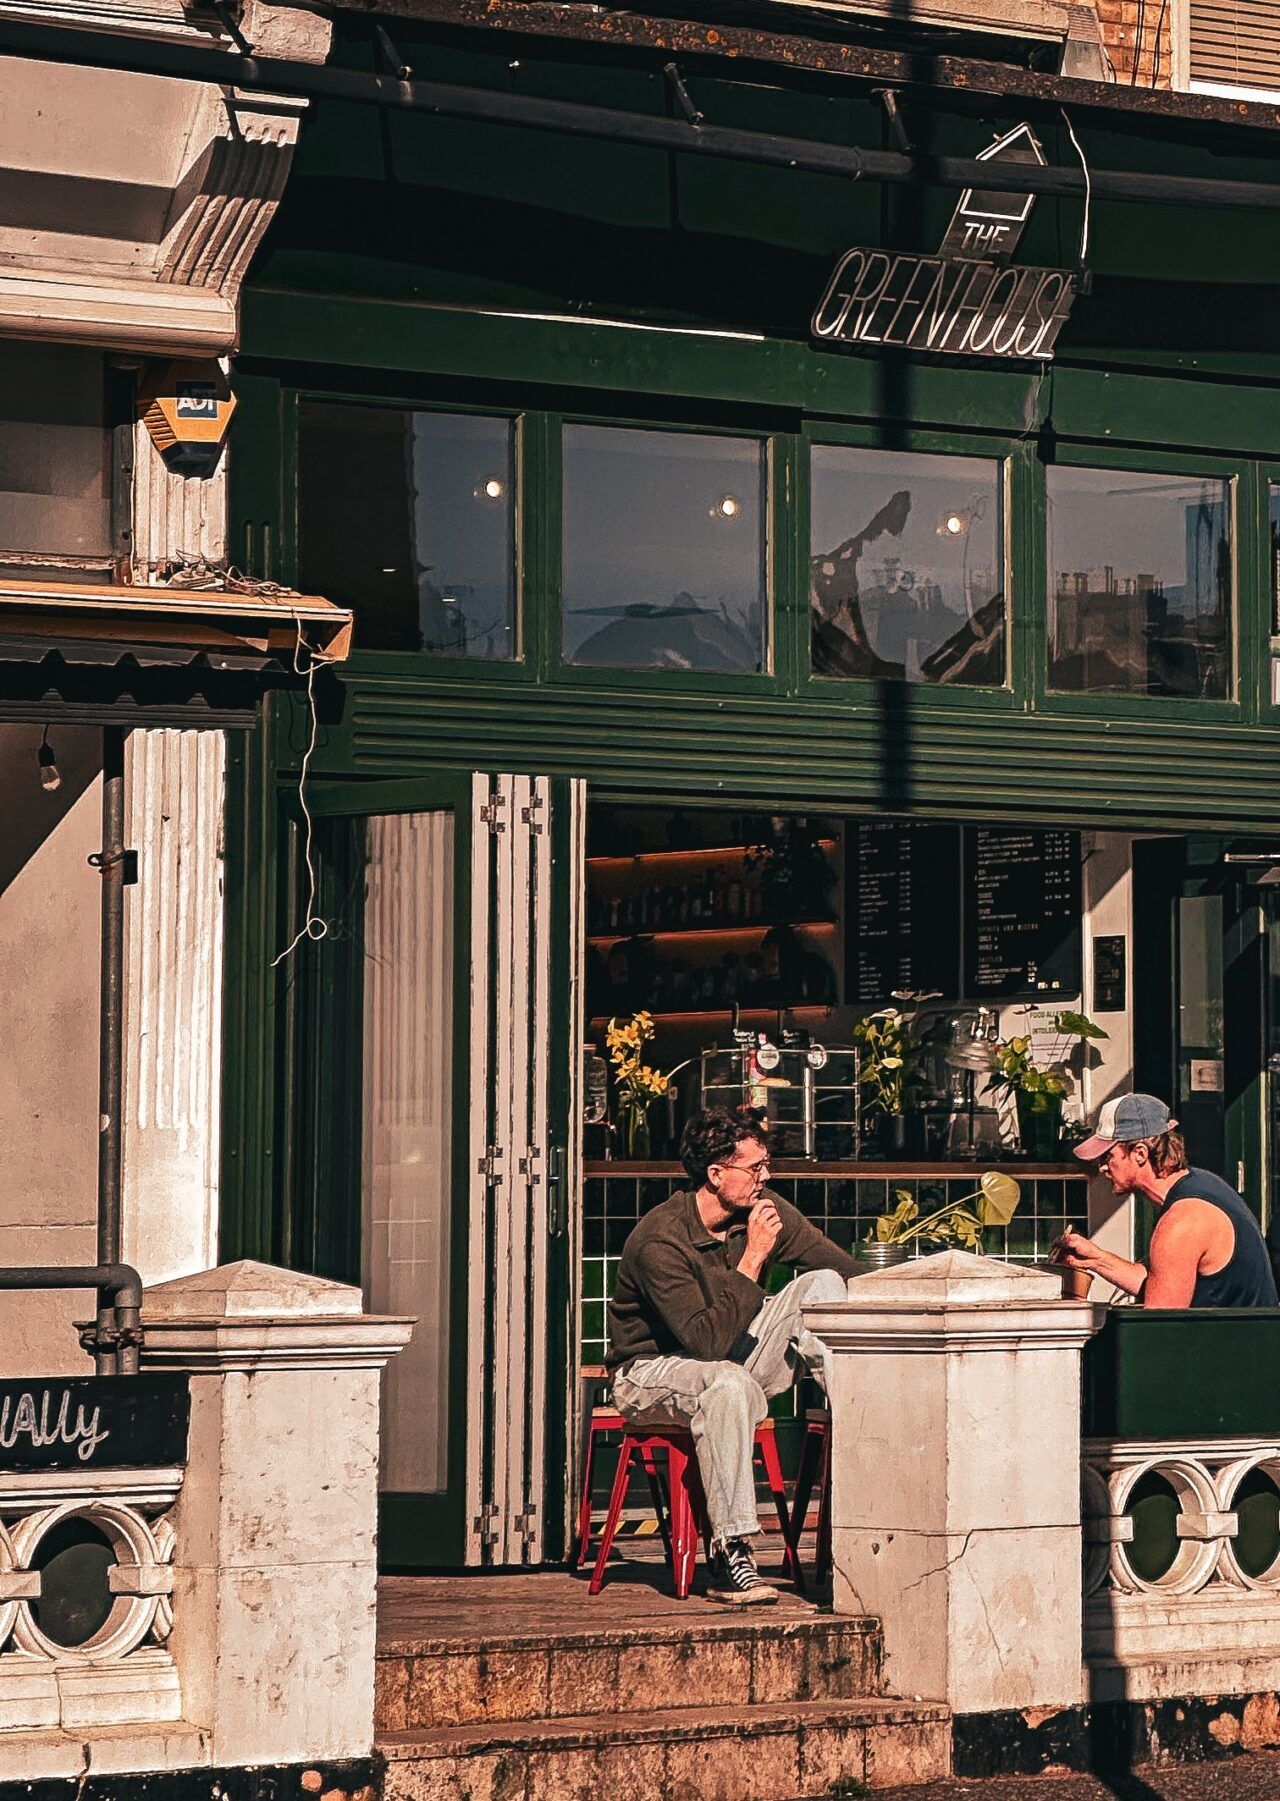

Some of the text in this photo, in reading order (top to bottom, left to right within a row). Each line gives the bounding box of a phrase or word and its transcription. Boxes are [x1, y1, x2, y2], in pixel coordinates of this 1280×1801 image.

[962, 221, 1010, 252] THE
[814, 249, 1075, 358] GREENHOUSE
[177, 388, 217, 411] ADT
